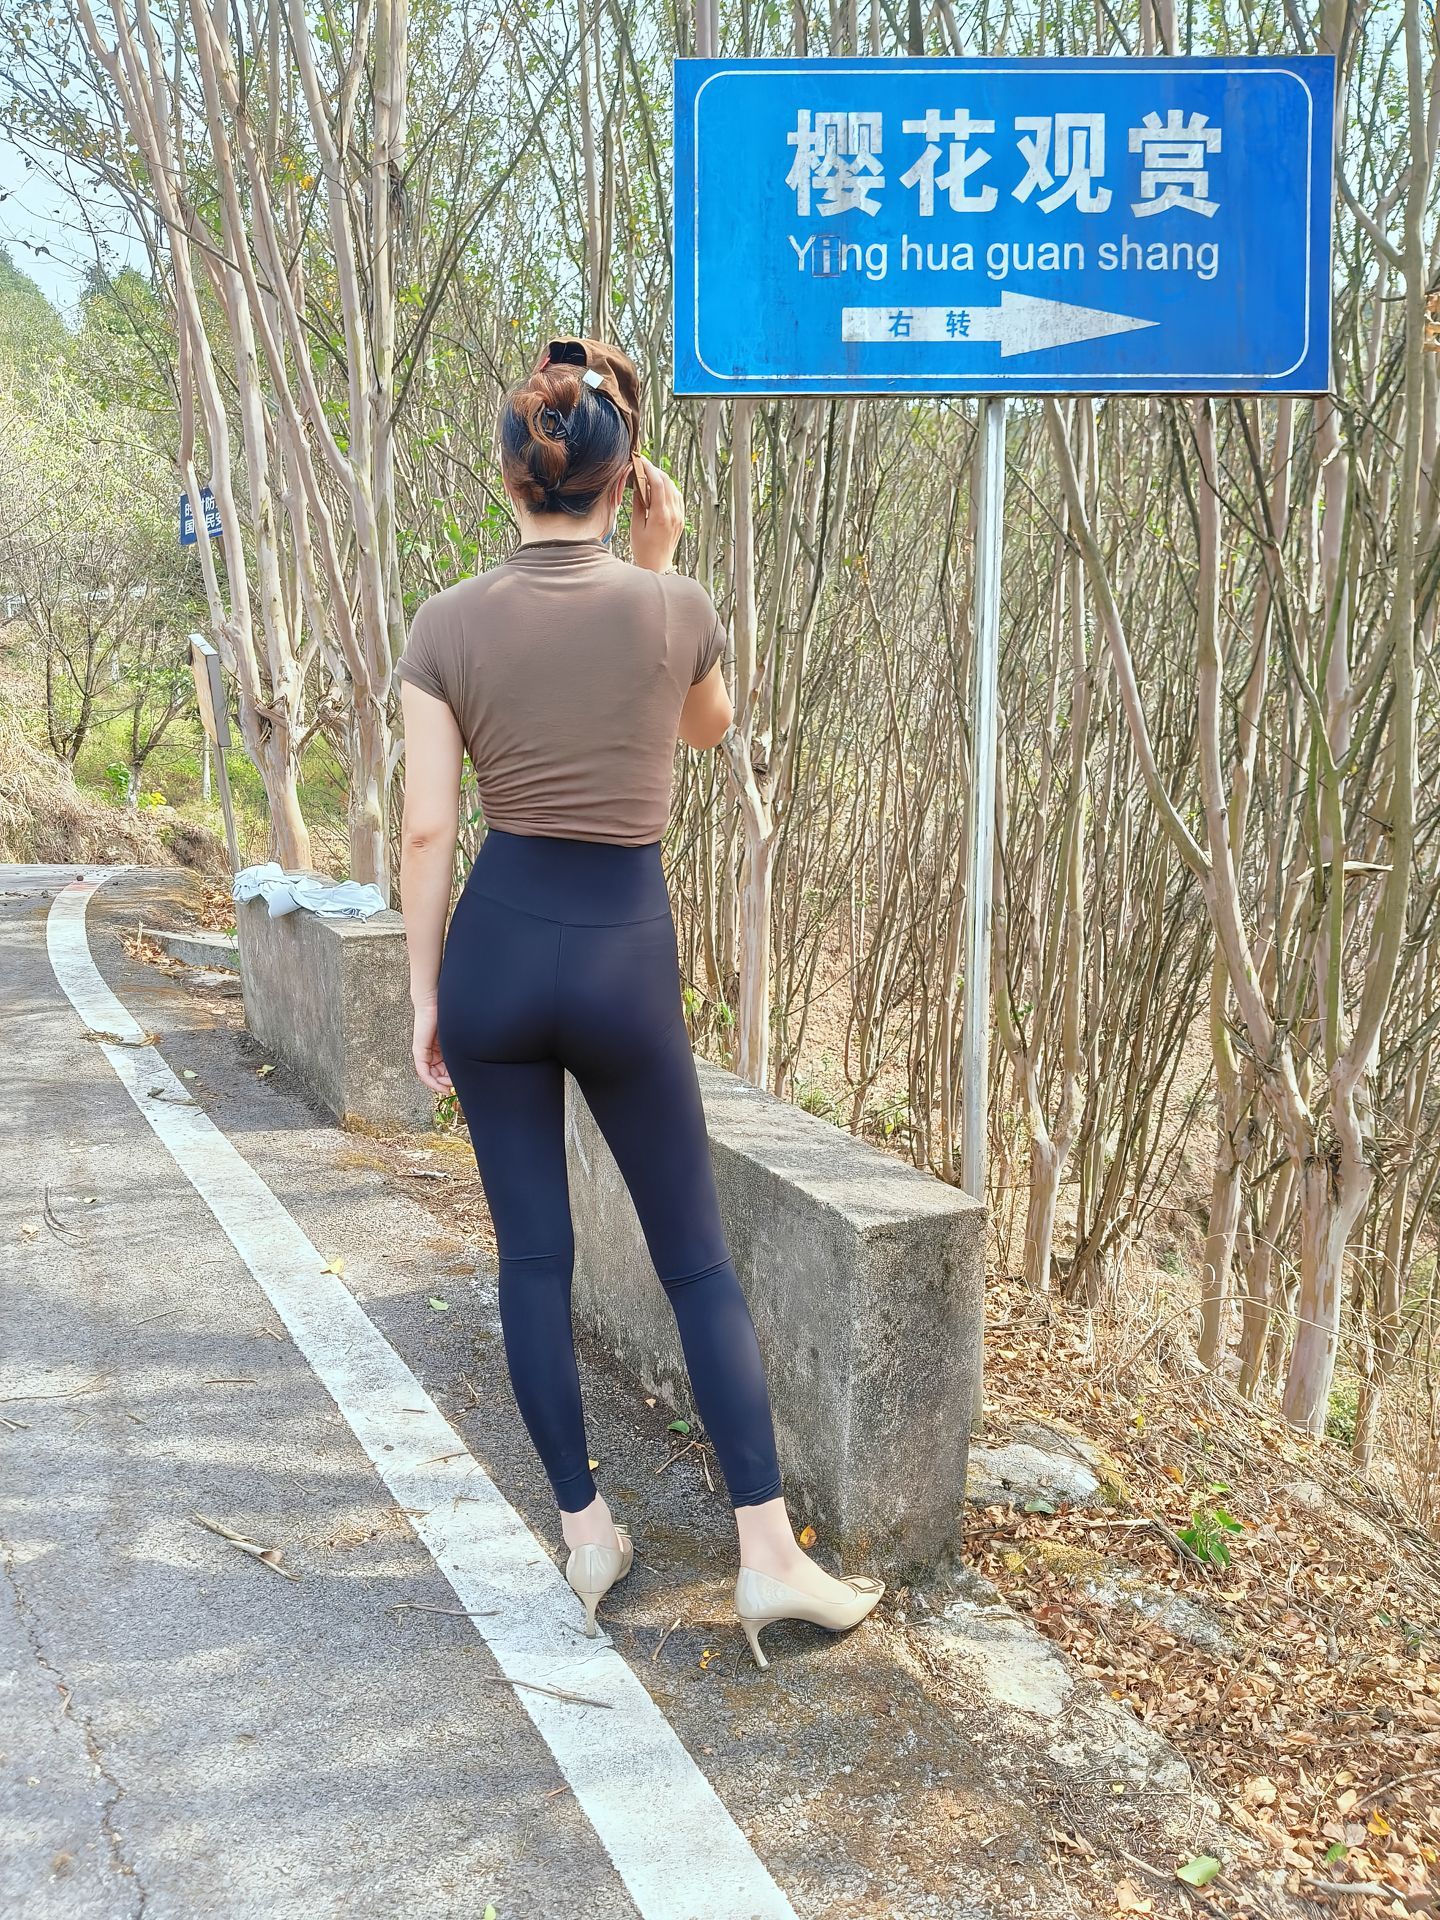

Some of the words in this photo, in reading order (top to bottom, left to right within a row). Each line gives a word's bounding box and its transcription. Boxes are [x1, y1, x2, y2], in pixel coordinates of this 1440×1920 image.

[785, 108, 1222, 218] 樱花观赏
[789, 234, 888, 281] Ying
[901, 234, 974, 272] hua
[986, 242, 1085, 280] guan
[1098, 233, 1219, 280] shang
[887, 309, 972, 338] 右转
